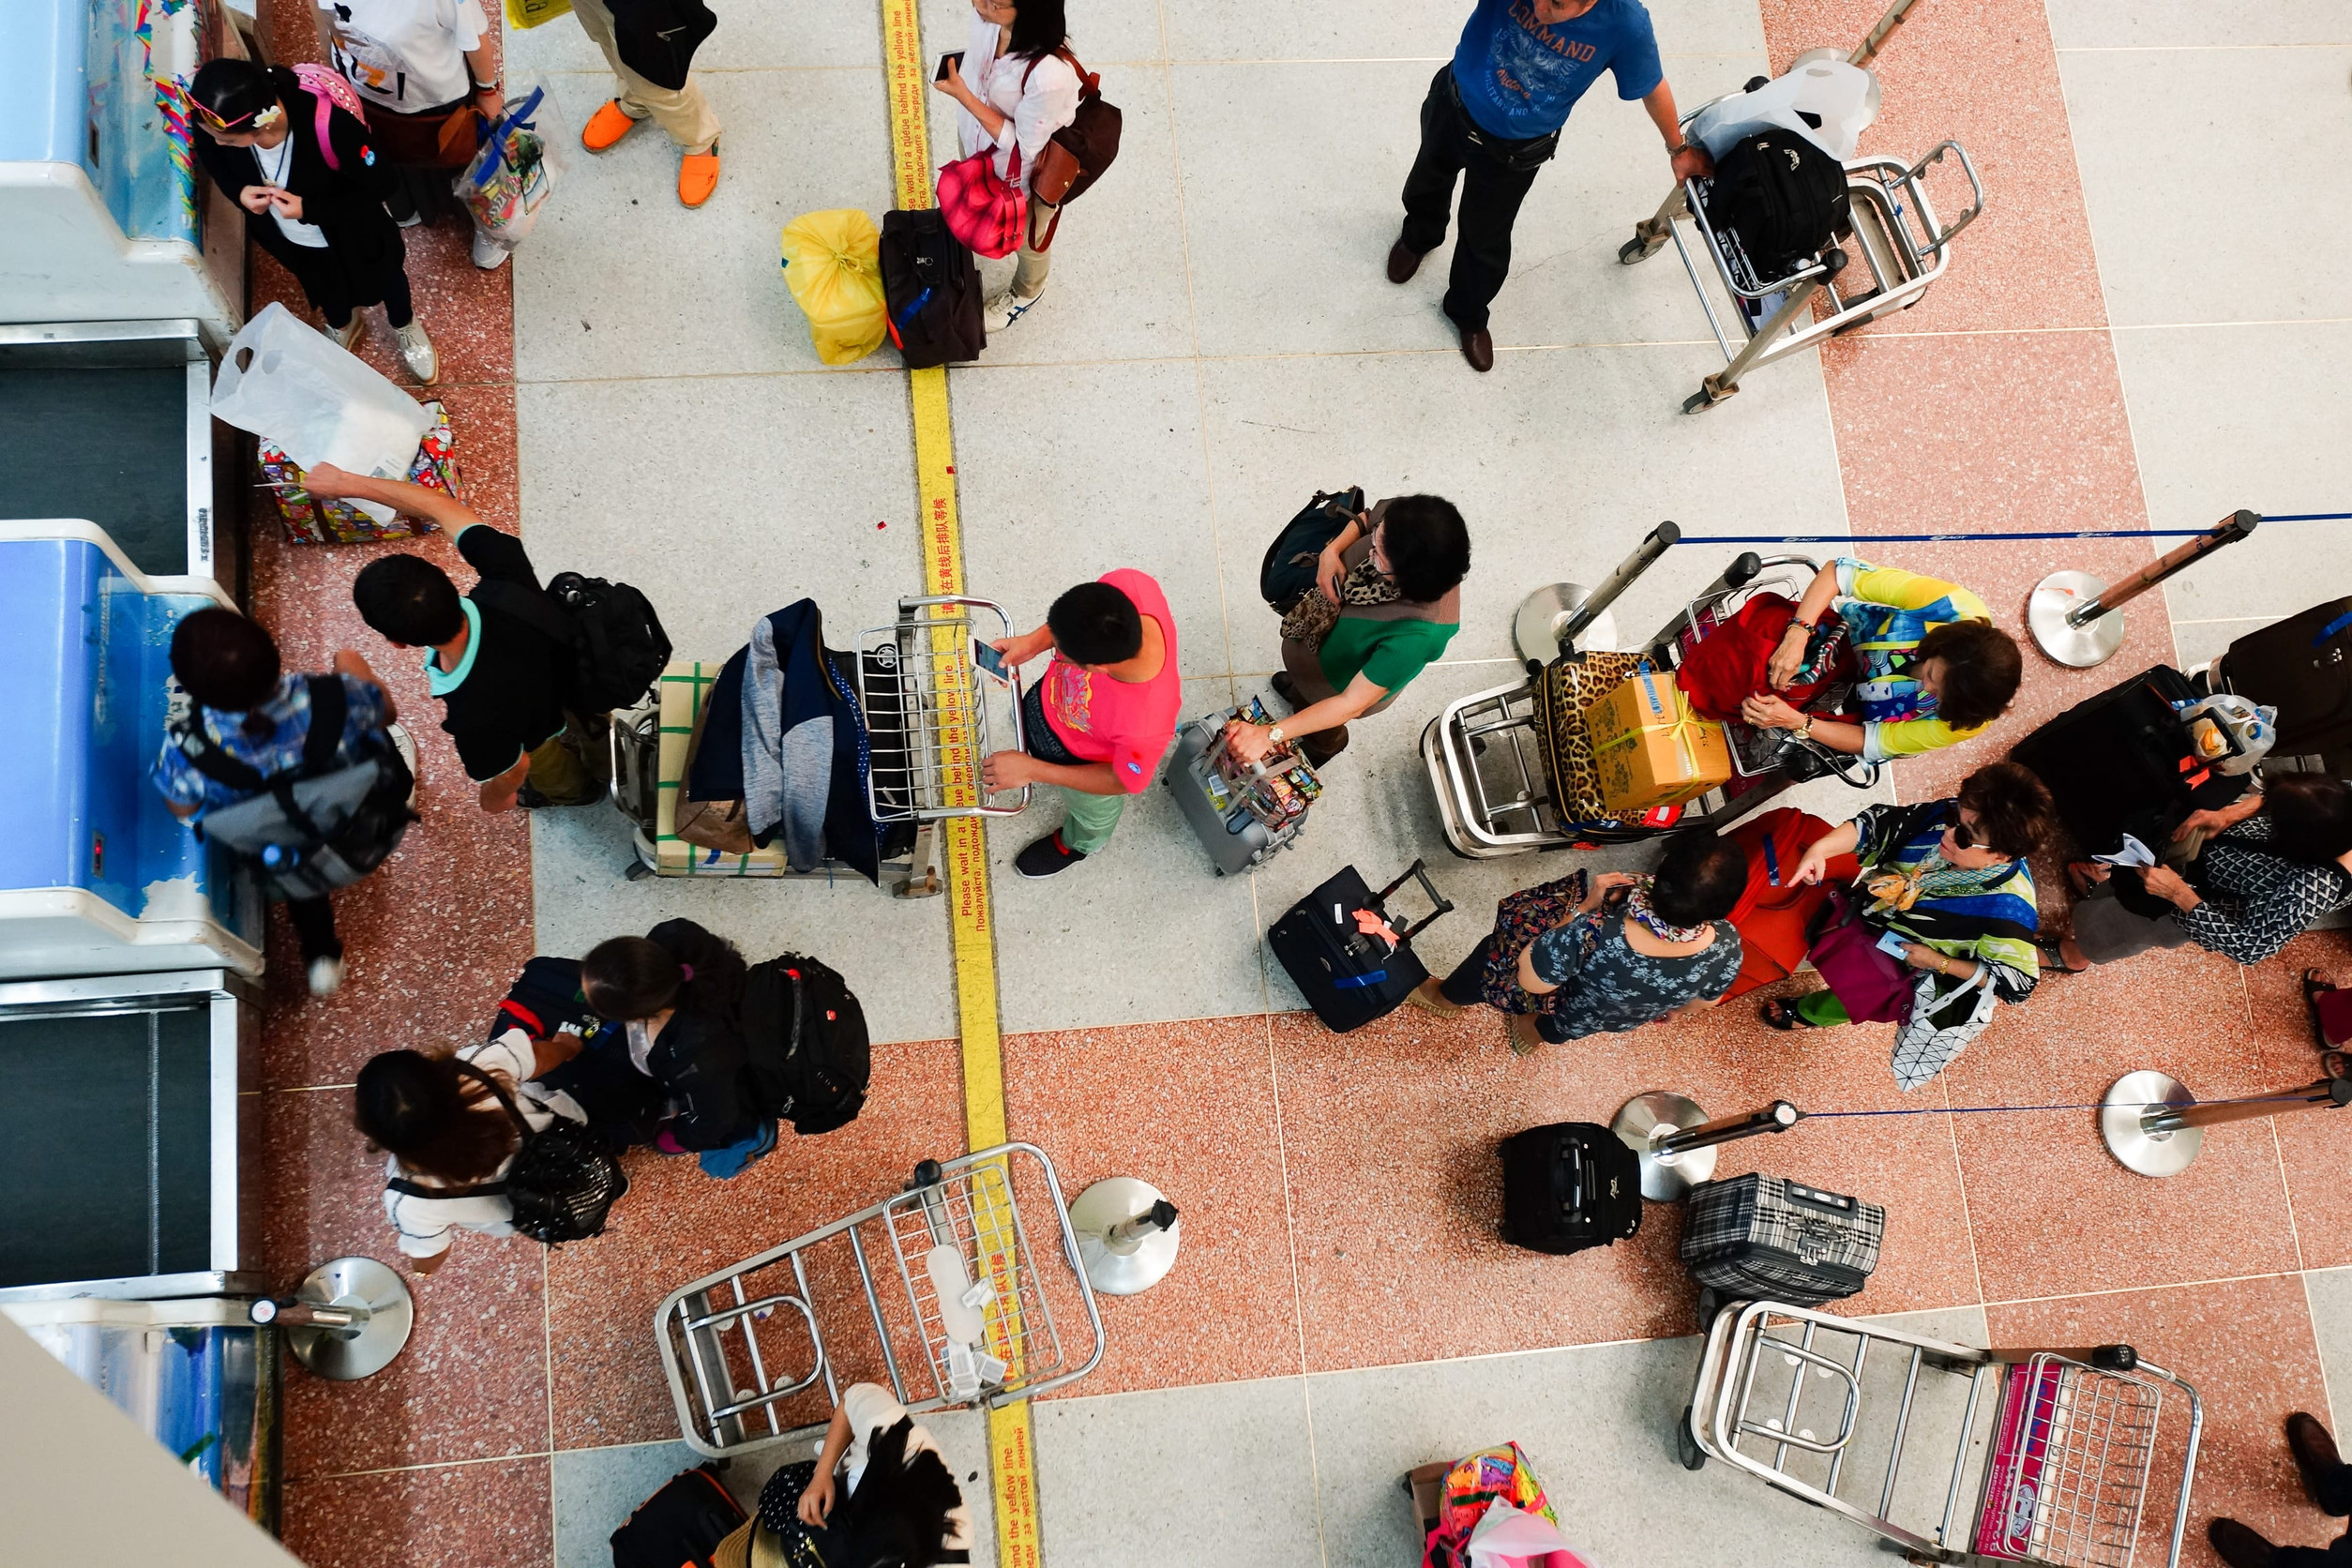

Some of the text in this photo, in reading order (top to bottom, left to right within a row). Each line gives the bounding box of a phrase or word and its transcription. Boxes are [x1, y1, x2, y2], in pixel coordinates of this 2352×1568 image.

[892, 10, 901, 27] line
[1508, 0, 1597, 63] COMMAND
[892, 30, 907, 61] yellow
[905, 32, 915, 64] желтой
[896, 64, 906, 79] the
[910, 68, 917, 78] за
[897, 83, 909, 115] behind
[911, 84, 921, 121] очереди
[901, 118, 912, 147] queue
[903, 161, 913, 171] in
[914, 134, 926, 184] подождите
[904, 173, 915, 194] wait
[932, 497, 956, 614] 请在黄线后排队等候
[948, 727, 958, 744] the
[957, 837, 967, 848] in
[958, 852, 970, 876] wait
[961, 880, 972, 916] Please
[973, 867, 986, 932] Пожалуйста,
[1003, 1447, 1014, 1470] line
[1004, 1474, 1020, 1515] yellow
[1008, 1519, 1019, 1539] the
[1024, 1523, 1033, 1536] за
